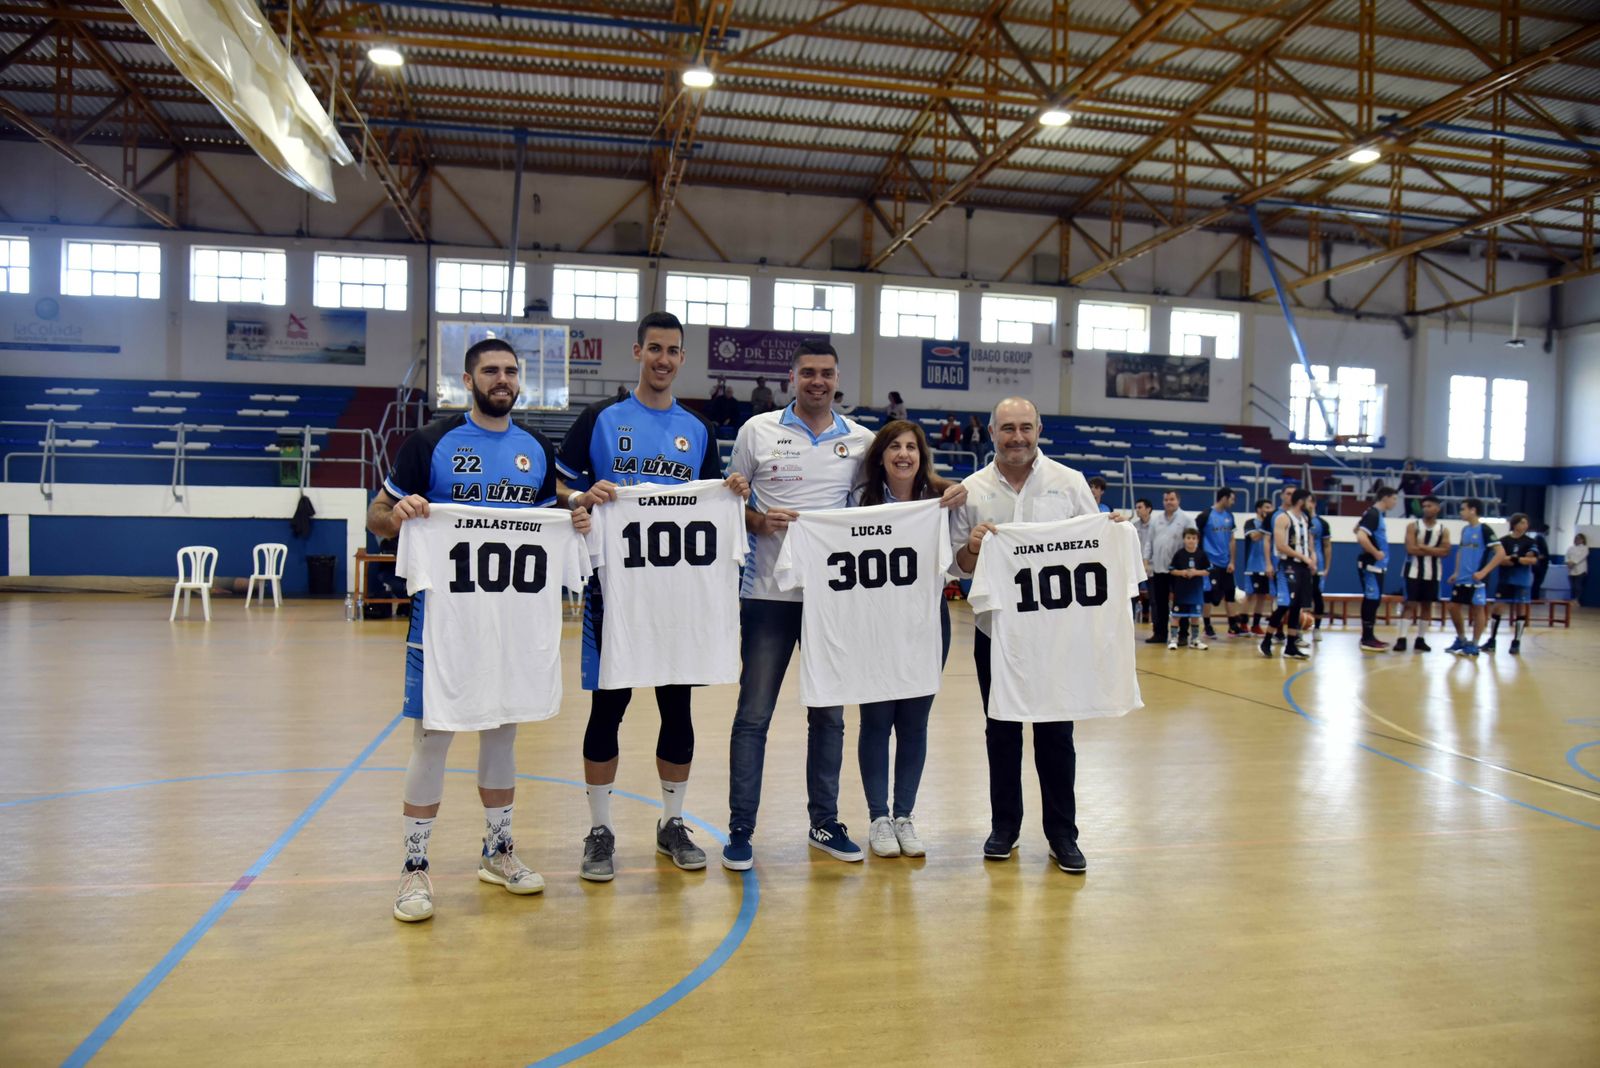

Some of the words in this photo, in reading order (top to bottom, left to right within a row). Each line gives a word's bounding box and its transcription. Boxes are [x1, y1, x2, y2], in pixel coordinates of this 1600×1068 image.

[971, 349, 1001, 362] UBAGO
[1003, 351, 1033, 364] GROUP
[927, 365, 964, 384] UBAGO
[618, 436, 632, 453] 0
[452, 454, 483, 474] 22
[612, 456, 638, 473] LA
[641, 453, 694, 482] LÍNEA
[452, 482, 482, 502] LA
[638, 495, 698, 507] CANDIDO
[454, 518, 543, 533] J.BALASTEGUI
[851, 524, 893, 537] LUCAS
[621, 520, 718, 569] 100
[1013, 544, 1045, 556] JUAN
[1047, 539, 1100, 552] CABEZAS
[449, 541, 548, 594] 100
[826, 546, 918, 592] 300
[1014, 561, 1108, 613] 100
